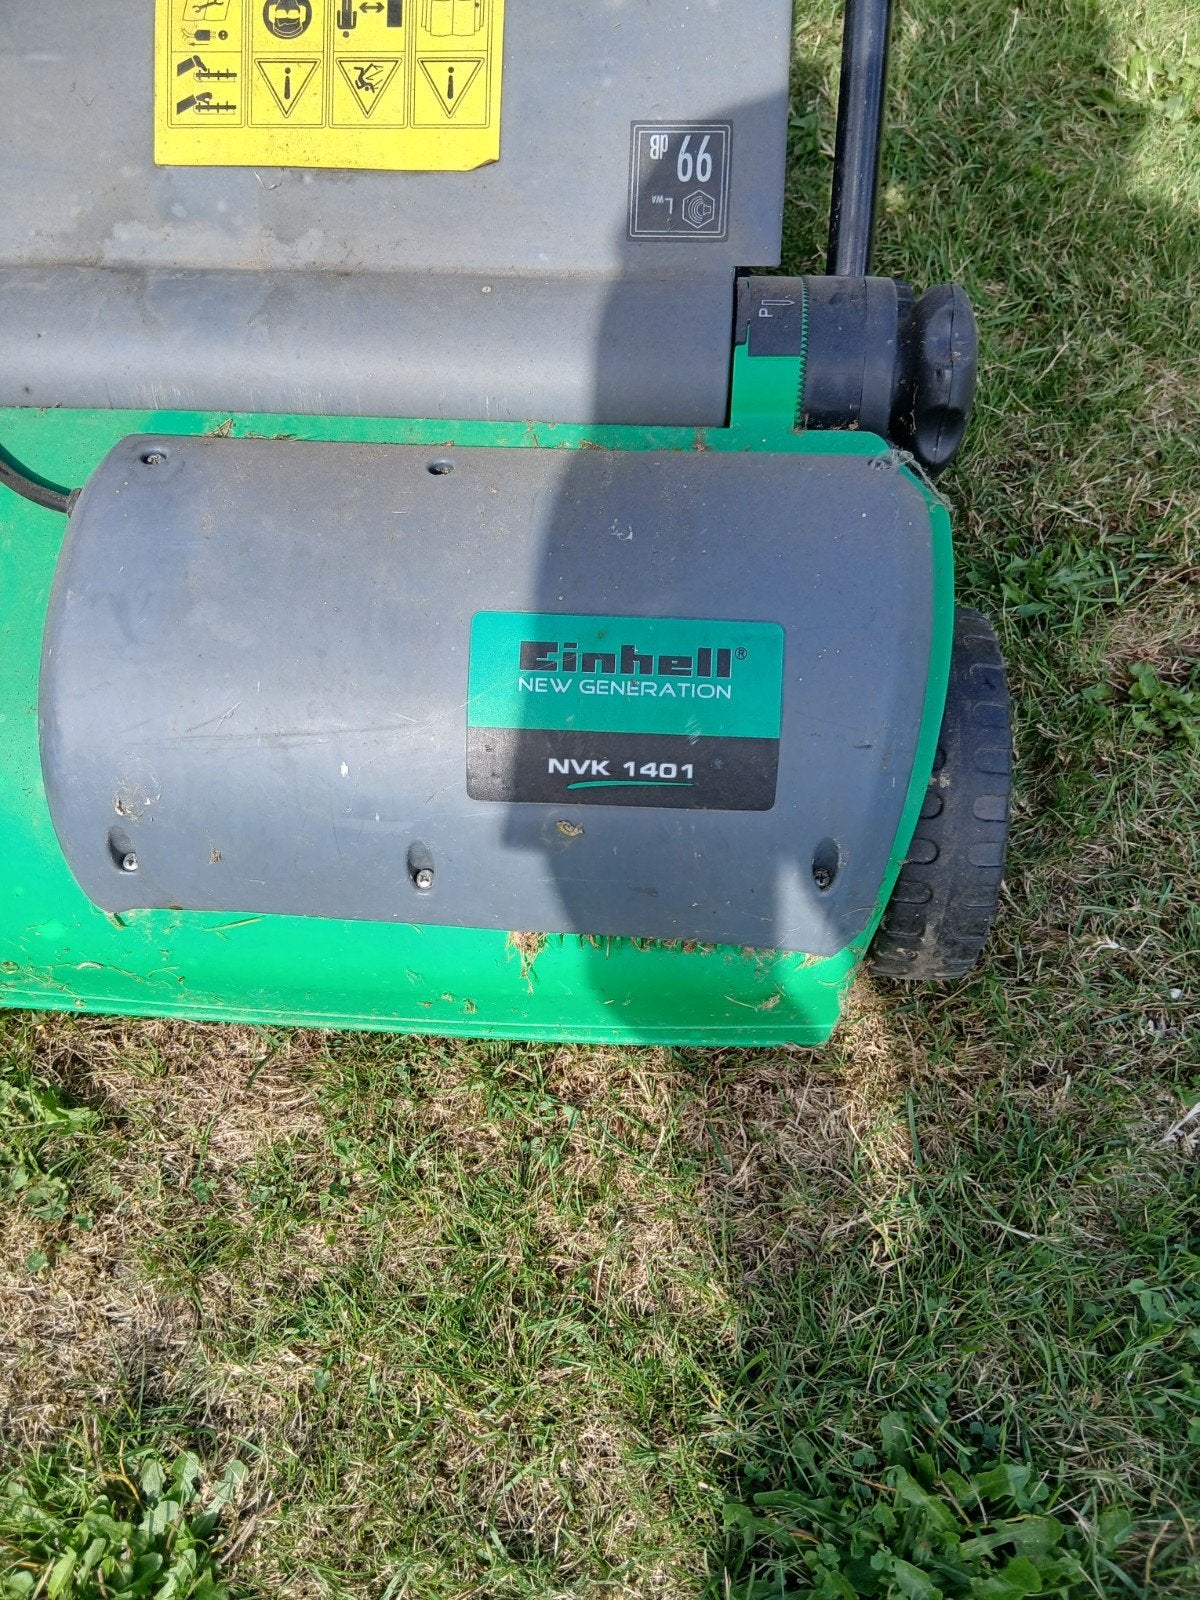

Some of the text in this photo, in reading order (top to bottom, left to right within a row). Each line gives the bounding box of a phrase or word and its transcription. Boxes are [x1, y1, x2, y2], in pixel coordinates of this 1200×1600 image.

[650, 134, 712, 182] 99 dB
[518, 677, 732, 699] NEW GENERATION
[548, 758, 694, 779] NVK 1401
